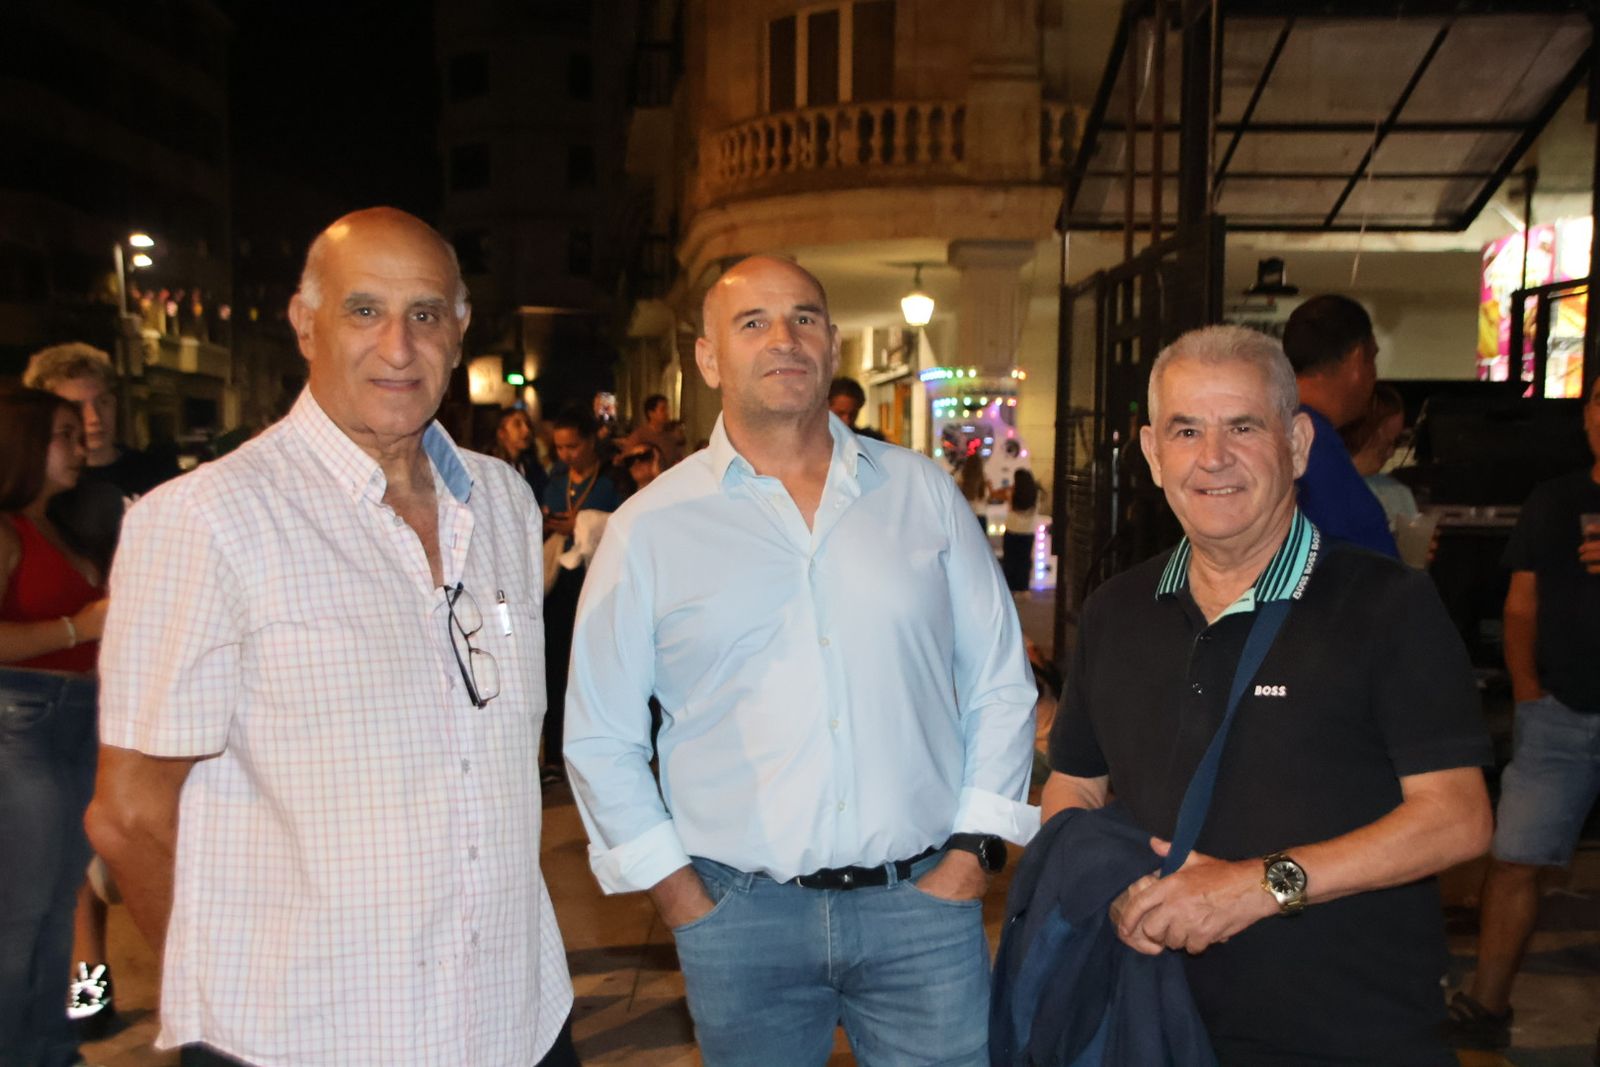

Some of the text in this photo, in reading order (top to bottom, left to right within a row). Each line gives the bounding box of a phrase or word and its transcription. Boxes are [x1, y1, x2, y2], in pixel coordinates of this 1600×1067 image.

[1292, 575, 1309, 600] BOSS
[1304, 551, 1318, 574] BOSS
[1253, 684, 1287, 697] BOSS
